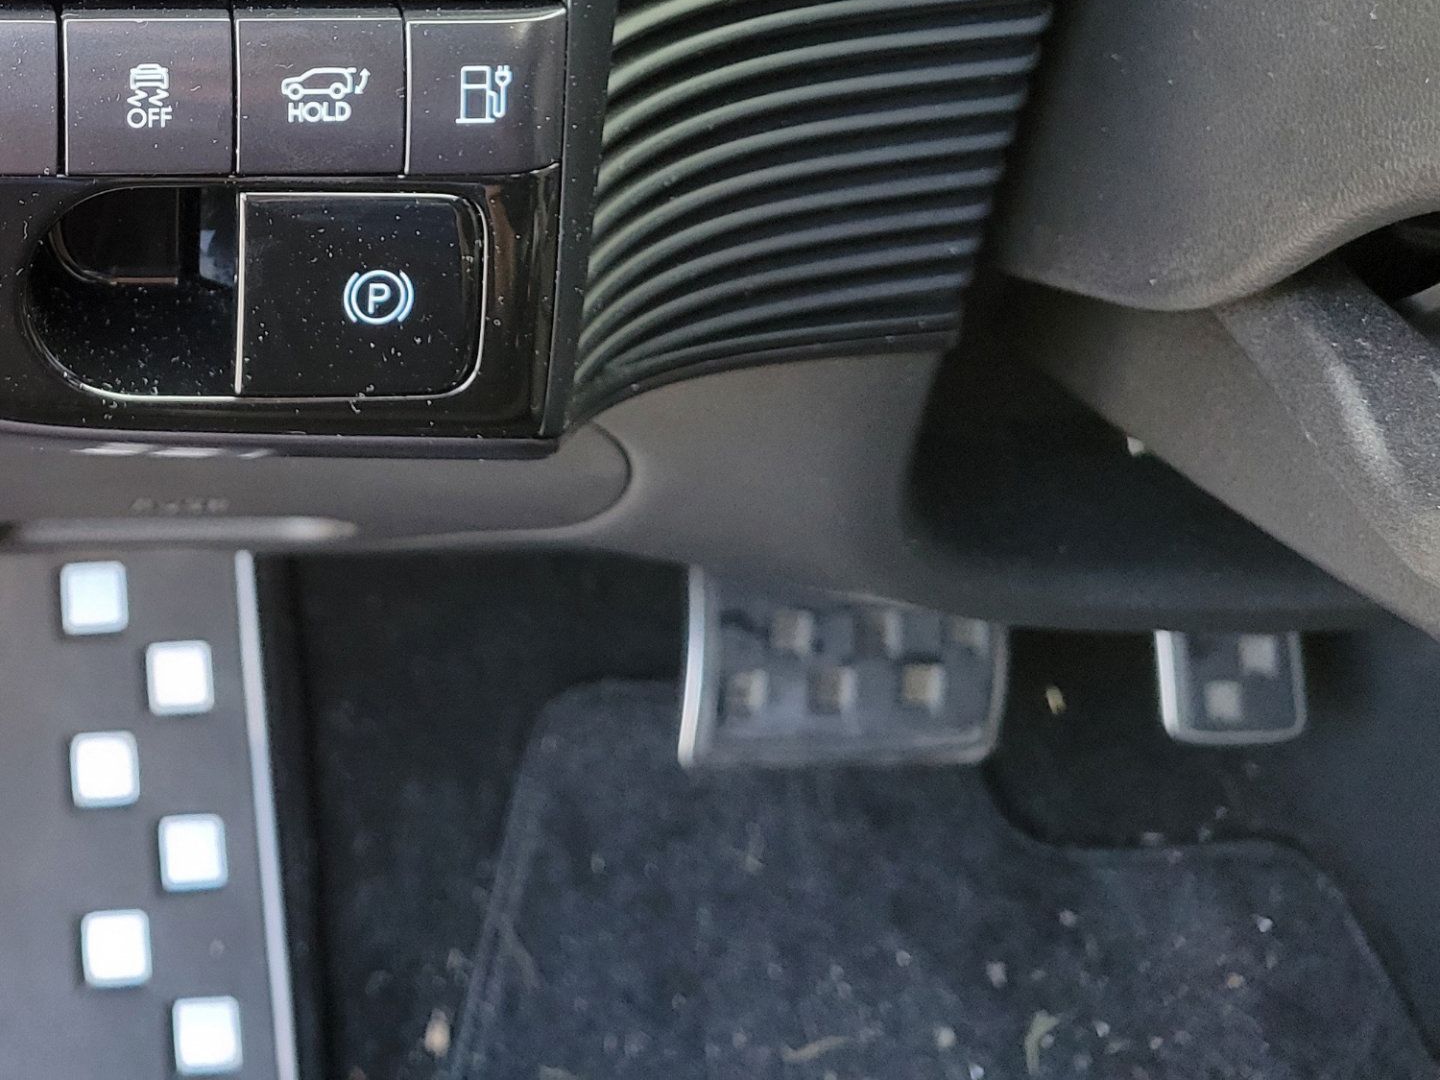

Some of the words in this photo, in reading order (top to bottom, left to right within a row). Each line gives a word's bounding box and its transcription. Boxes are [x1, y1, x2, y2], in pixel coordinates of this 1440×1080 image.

[127, 107, 172, 128] OFF
[288, 102, 351, 122] HOLD
[368, 283, 391, 314] P
